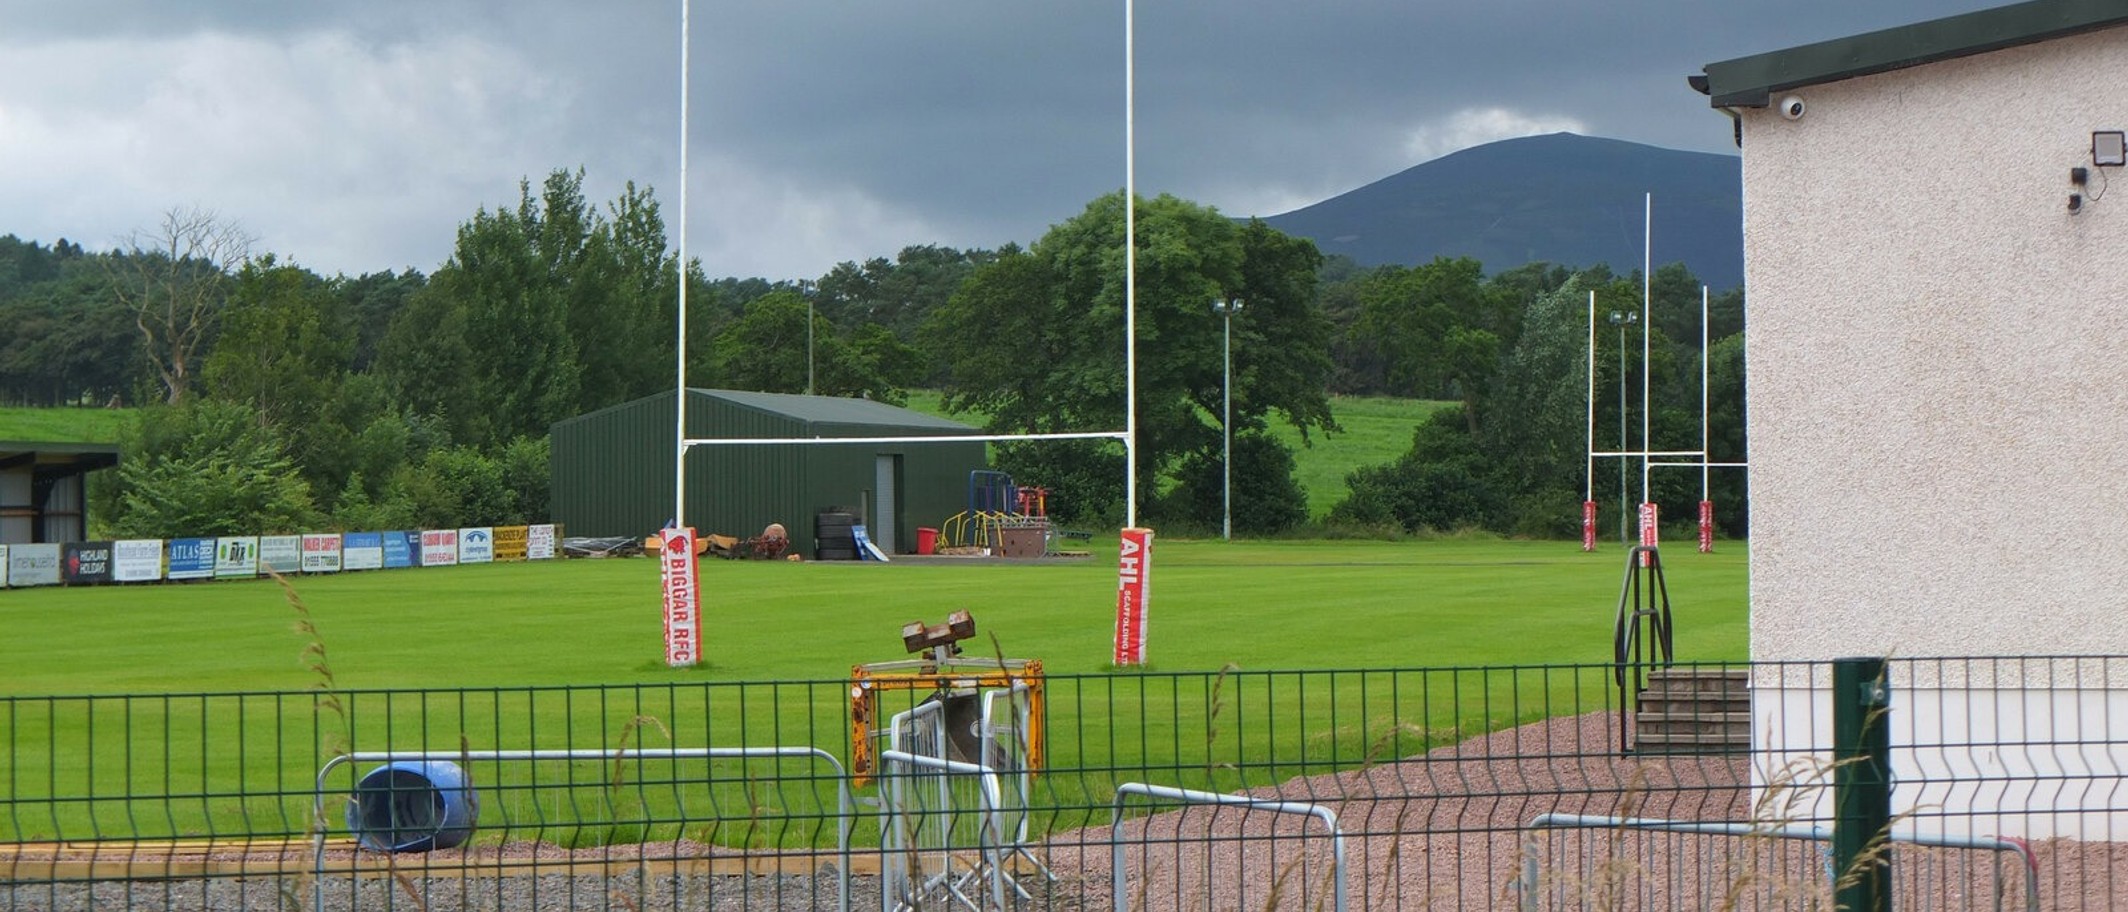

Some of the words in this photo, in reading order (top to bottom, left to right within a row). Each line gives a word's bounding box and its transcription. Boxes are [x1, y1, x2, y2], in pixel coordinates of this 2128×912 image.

[80, 549, 108, 561] HIGHLAND
[80, 562, 105, 574] HOLIDAYS
[172, 545, 199, 559] ATLAS
[1119, 538, 1140, 590] AHL
[671, 558, 689, 622] BIGGAR
[1121, 590, 1131, 649] SCAFFOLDING
[674, 628, 690, 661] RFC
